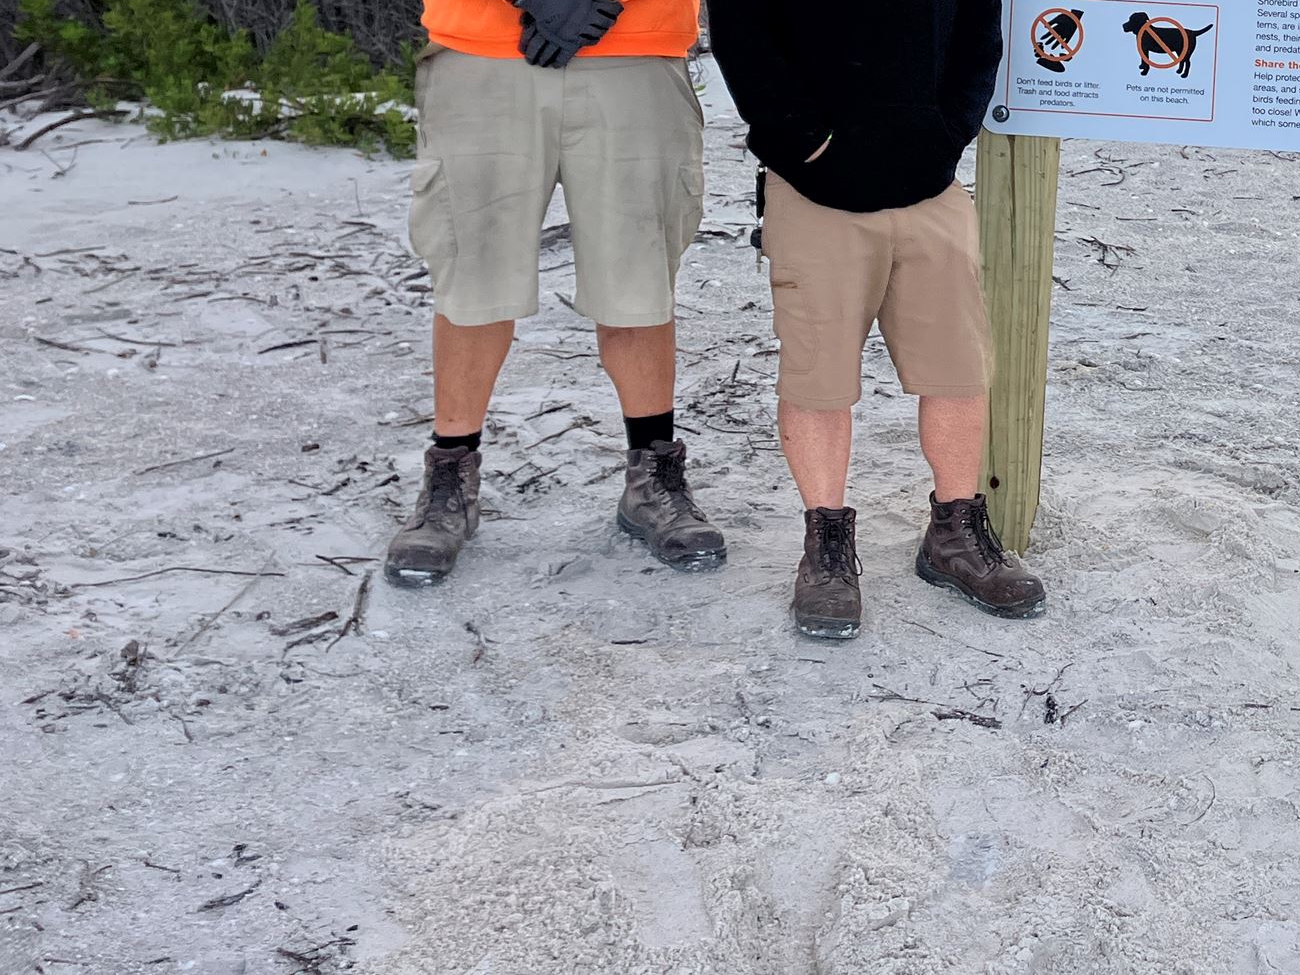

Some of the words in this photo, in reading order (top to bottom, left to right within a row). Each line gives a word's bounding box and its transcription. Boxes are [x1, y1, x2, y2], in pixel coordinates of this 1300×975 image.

[1257, 8, 1288, 18] Several
[1254, 59, 1285, 69] Share
[1254, 72, 1273, 82] Help
[1252, 118, 1276, 127] which
